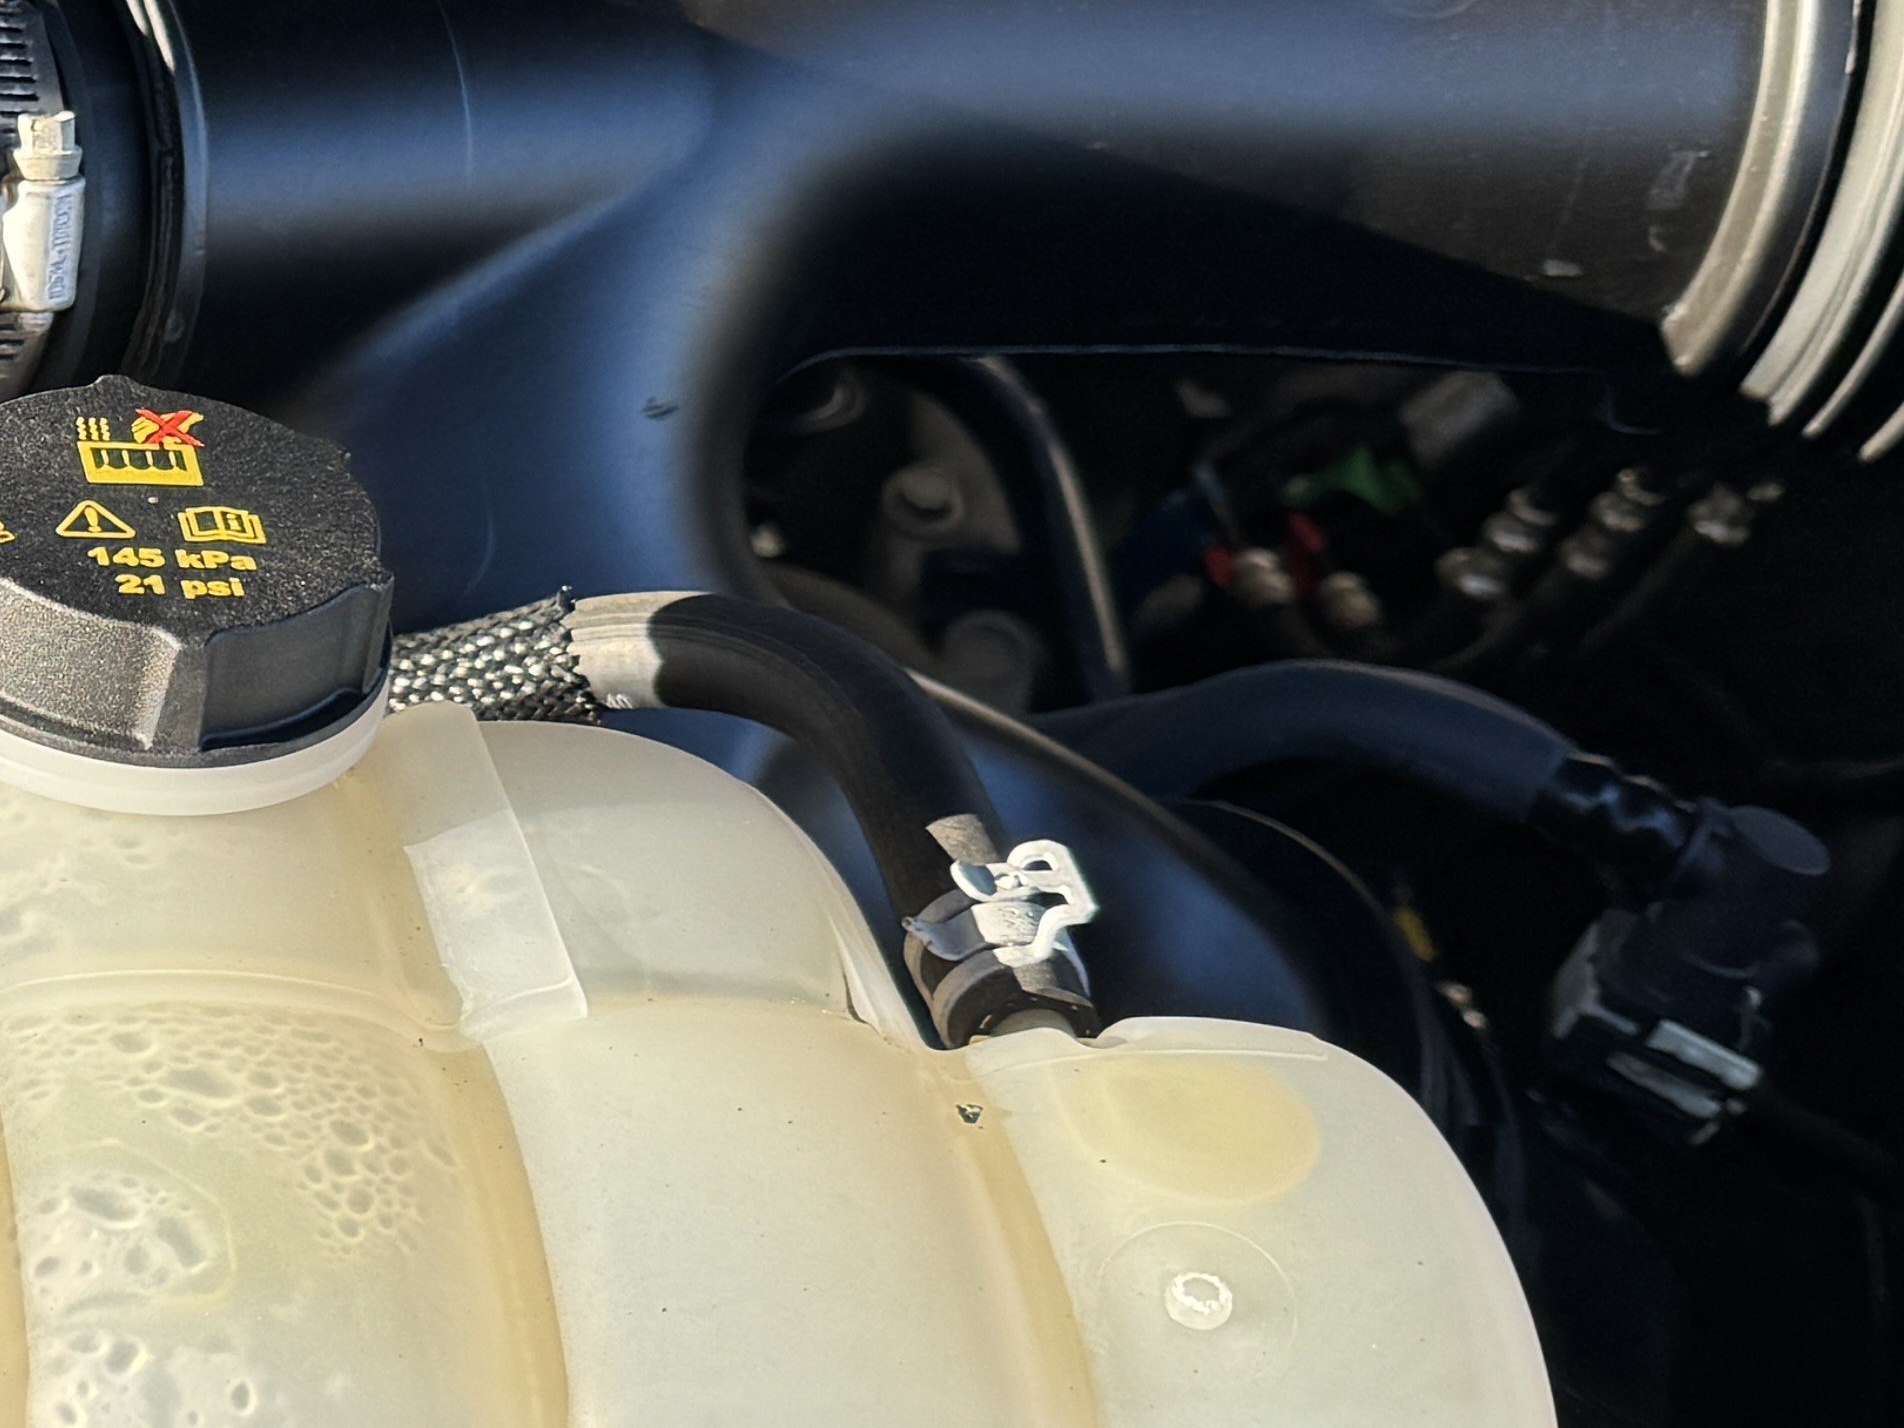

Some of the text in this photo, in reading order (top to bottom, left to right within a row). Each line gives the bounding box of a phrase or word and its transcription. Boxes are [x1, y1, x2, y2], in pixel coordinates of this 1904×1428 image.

[87, 546, 258, 571] 145 kPa
[114, 573, 245, 600] 21 psi
